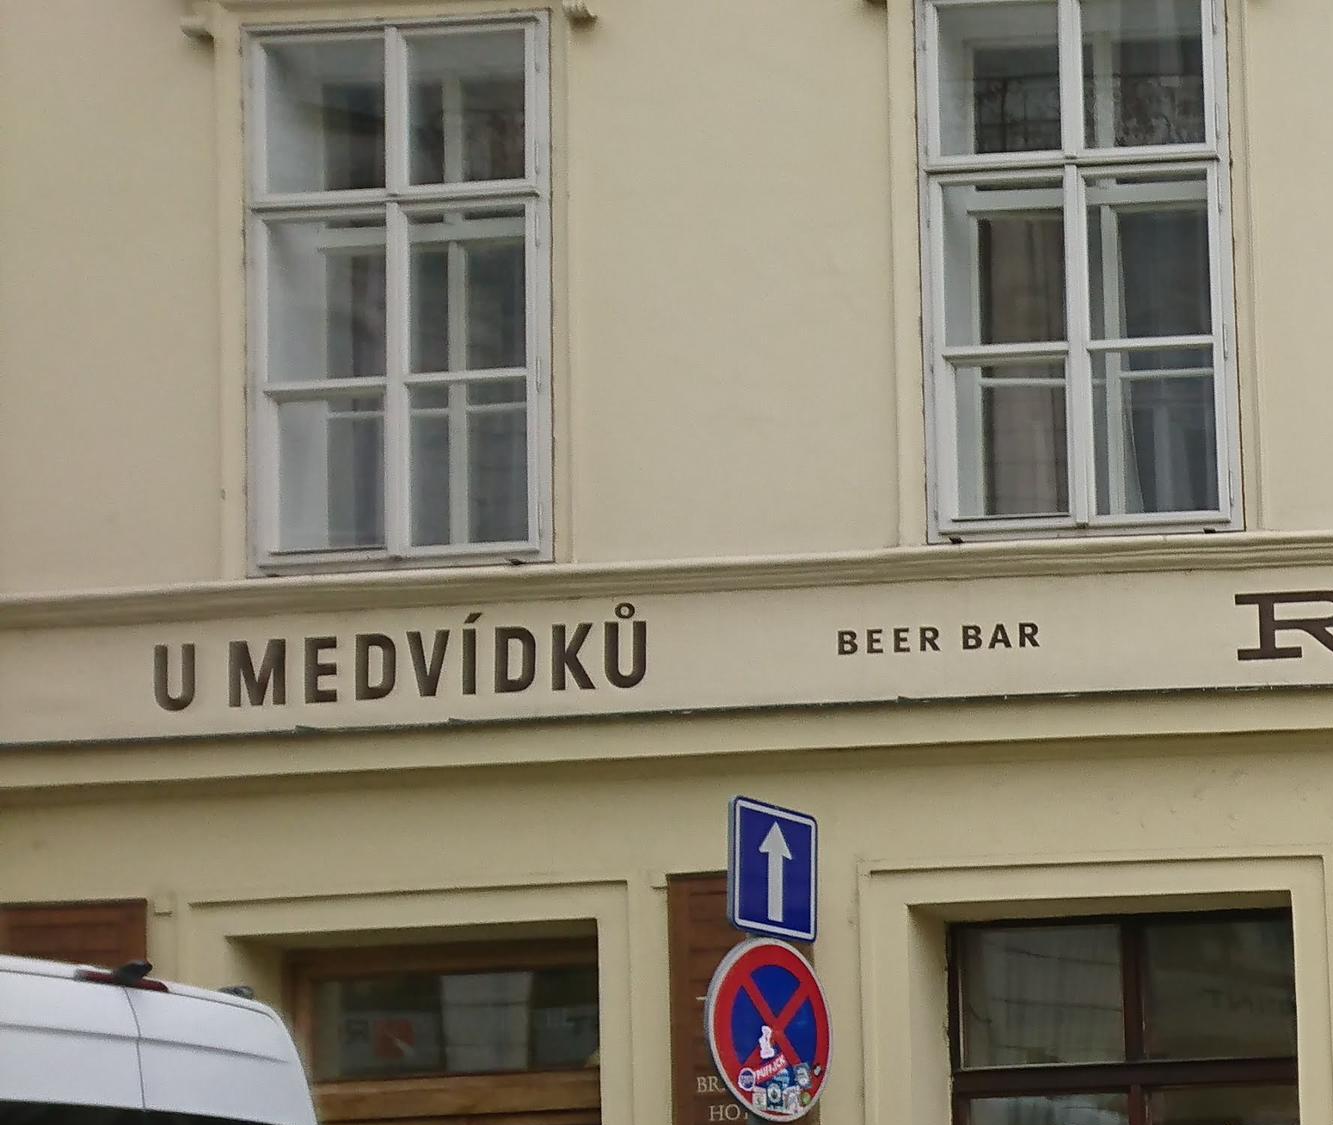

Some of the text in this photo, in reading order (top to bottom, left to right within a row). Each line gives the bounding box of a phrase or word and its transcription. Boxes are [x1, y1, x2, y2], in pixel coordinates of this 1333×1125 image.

[153, 602, 648, 711] U MEDVÍDKŮ
[837, 623, 1040, 655] BEER BAR
